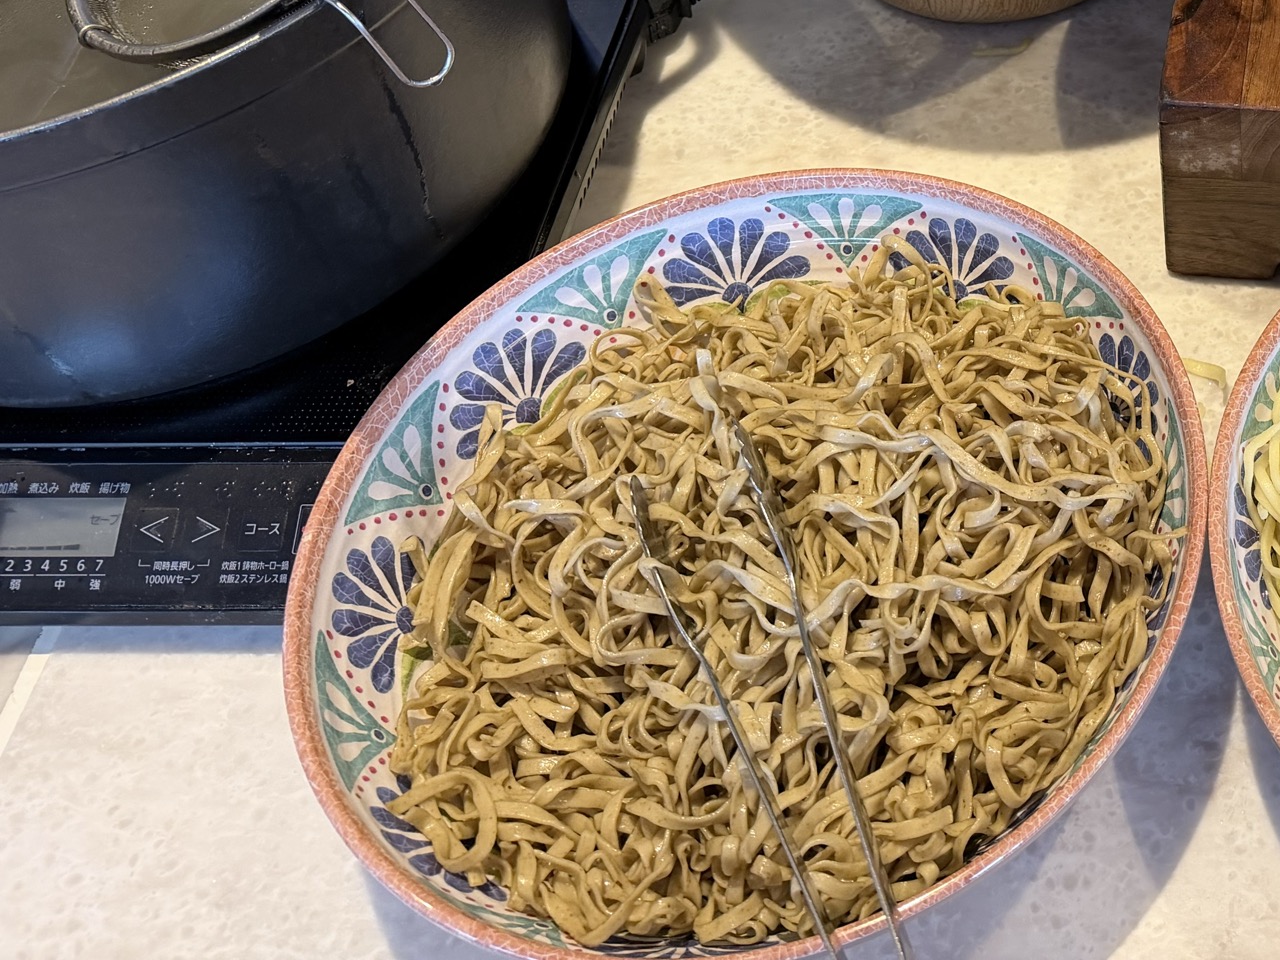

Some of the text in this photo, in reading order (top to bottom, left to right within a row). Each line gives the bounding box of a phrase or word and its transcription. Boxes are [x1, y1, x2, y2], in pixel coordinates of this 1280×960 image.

[28, 482, 59, 494] 煮込み
[69, 482, 91, 494] 炊飯
[99, 482, 131, 494] 揚げ物
[244, 523, 281, 535] コース
[5, 559, 104, 572] 2 3 4 5 6 7
[153, 560, 195, 571] 同時長押し
[9, 578, 101, 591] 弱 中 強
[145, 574, 200, 585] 1000Wセーブ
